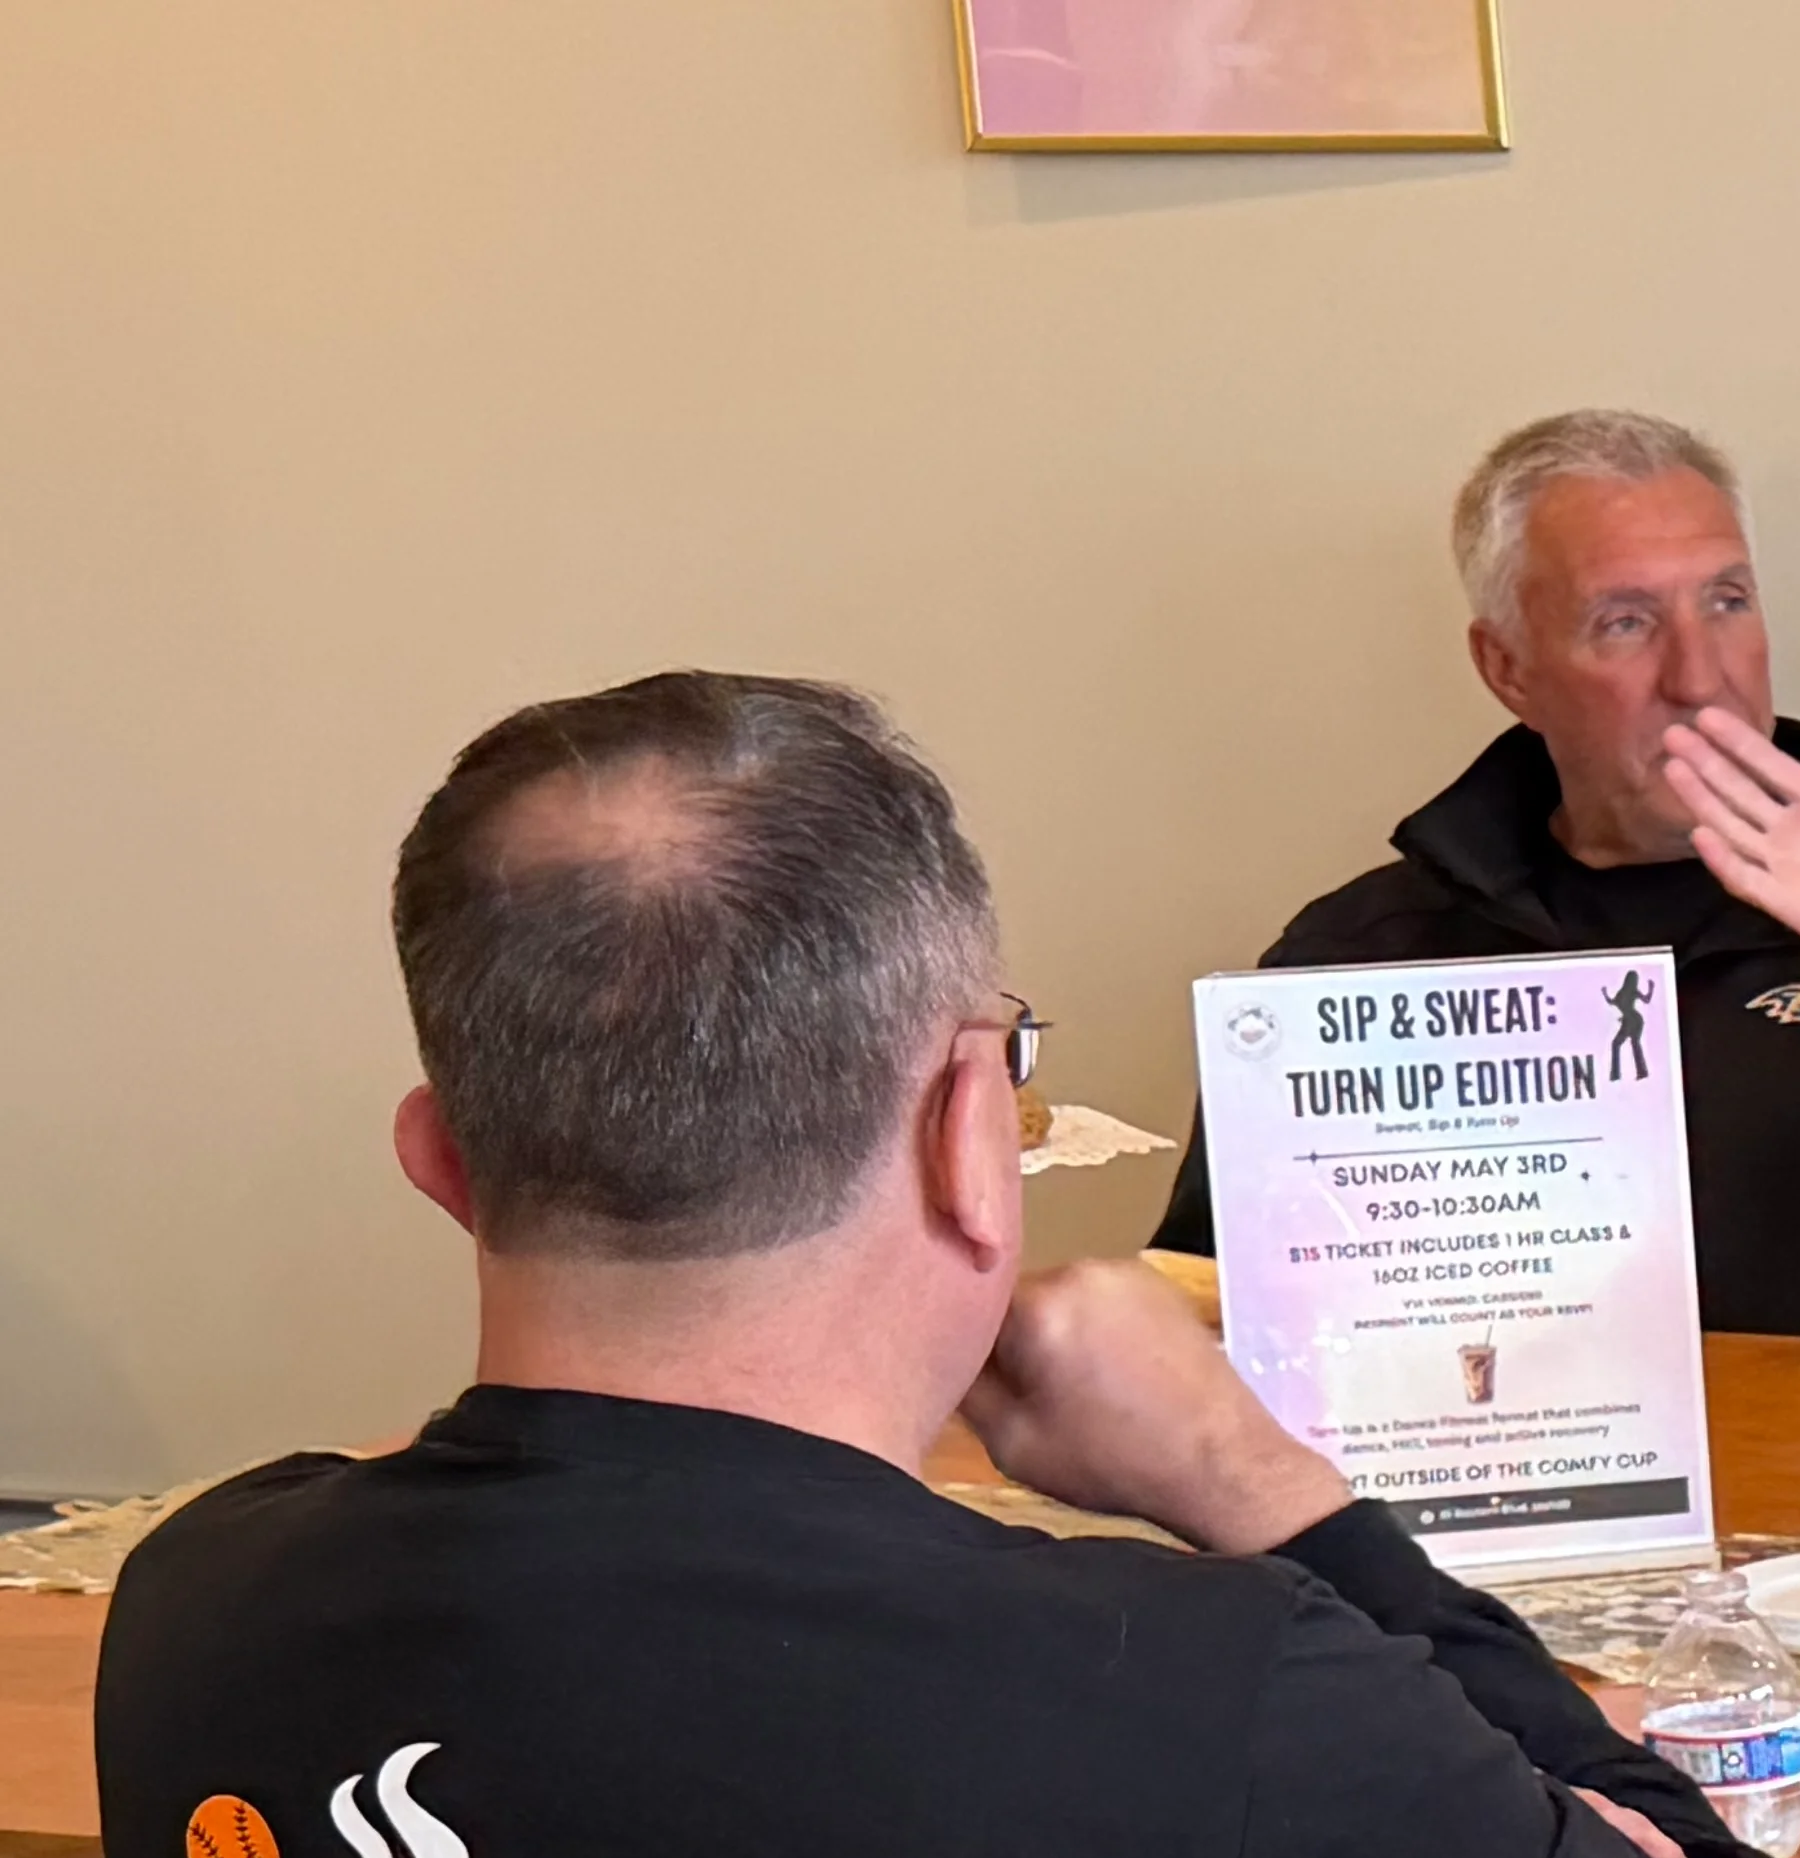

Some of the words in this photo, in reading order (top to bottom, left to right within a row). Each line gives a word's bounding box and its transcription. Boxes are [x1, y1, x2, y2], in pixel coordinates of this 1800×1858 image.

[1317, 996, 1378, 1043] SIP
[1390, 993, 1416, 1040] &
[1425, 986, 1557, 1037] SWEAT:
[1286, 1066, 1385, 1117] TURN
[1396, 1063, 1444, 1110] UP
[1456, 1054, 1596, 1107] EDITION
[1333, 1160, 1441, 1187] SUNDAY
[1450, 1155, 1508, 1180] MAY
[1516, 1153, 1567, 1175] 3RD
[1366, 1191, 1541, 1222] 9:30-10:30AM
[1289, 1245, 1321, 1263] $15
[1325, 1240, 1393, 1261] TICKET
[1400, 1232, 1501, 1255] INCLUDES
[1505, 1232, 1512, 1248] 1
[1518, 1230, 1544, 1246] HR
[1550, 1225, 1613, 1245] CLASS
[1619, 1224, 1631, 1240] &
[1373, 1266, 1419, 1286] 16OZ
[1425, 1262, 1473, 1281] ICED
[1478, 1256, 1554, 1277] COFFEE
[1450, 1309, 1496, 1323] COUNT
[1499, 1308, 1515, 1320] AS
[1518, 1306, 1553, 1319] YOUR
[1542, 1407, 1571, 1420] that
[1575, 1403, 1641, 1418] combines
[1475, 1430, 1501, 1444] and
[1374, 1466, 1461, 1488] OUTSIDE
[1466, 1463, 1492, 1480] OF
[1496, 1460, 1534, 1478] THE
[1537, 1454, 1612, 1476] COMFY
[1616, 1451, 1658, 1469] CUP
